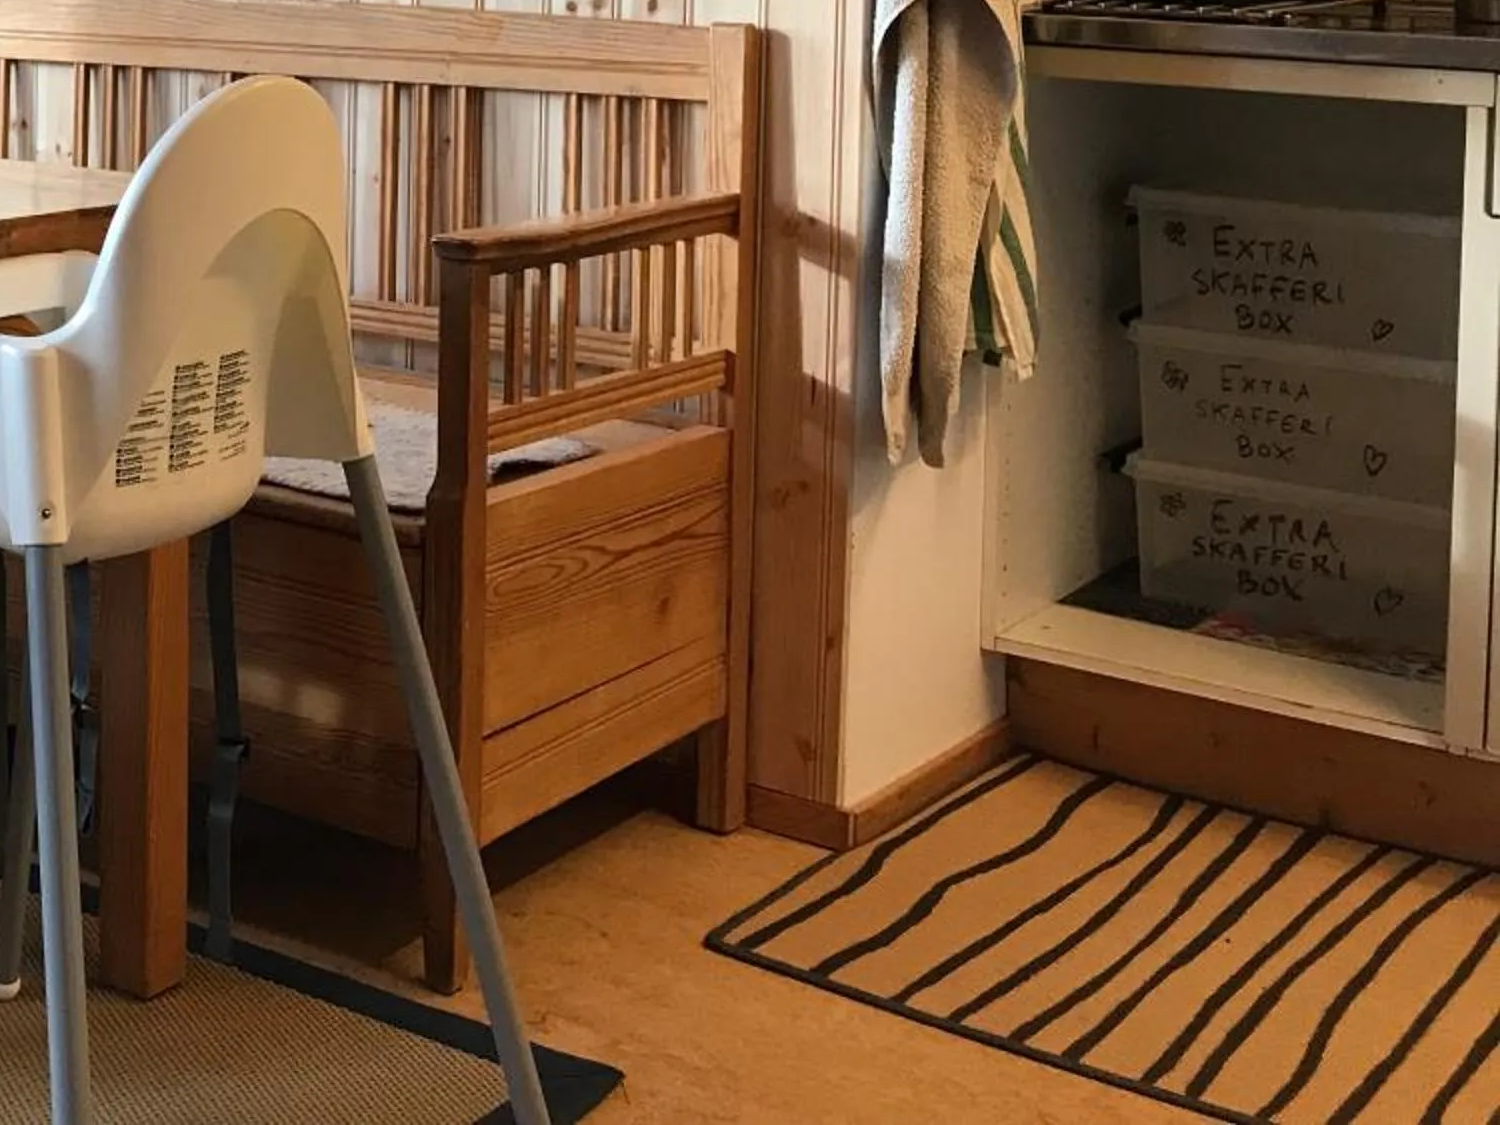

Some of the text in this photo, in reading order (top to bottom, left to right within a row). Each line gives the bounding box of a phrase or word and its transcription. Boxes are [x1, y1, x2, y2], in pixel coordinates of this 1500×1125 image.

[1213, 224, 1319, 270] EXTRA
[1190, 268, 1346, 306] SKAFFERI
[1234, 303, 1294, 334] BOX
[1219, 364, 1310, 403] EXTRA
[1195, 398, 1334, 437] SKAFFERI
[1235, 434, 1296, 466] BOX
[1210, 498, 1341, 553] EXTRA
[1191, 535, 1348, 581] SKAFFERI
[1237, 568, 1304, 601] BOX
